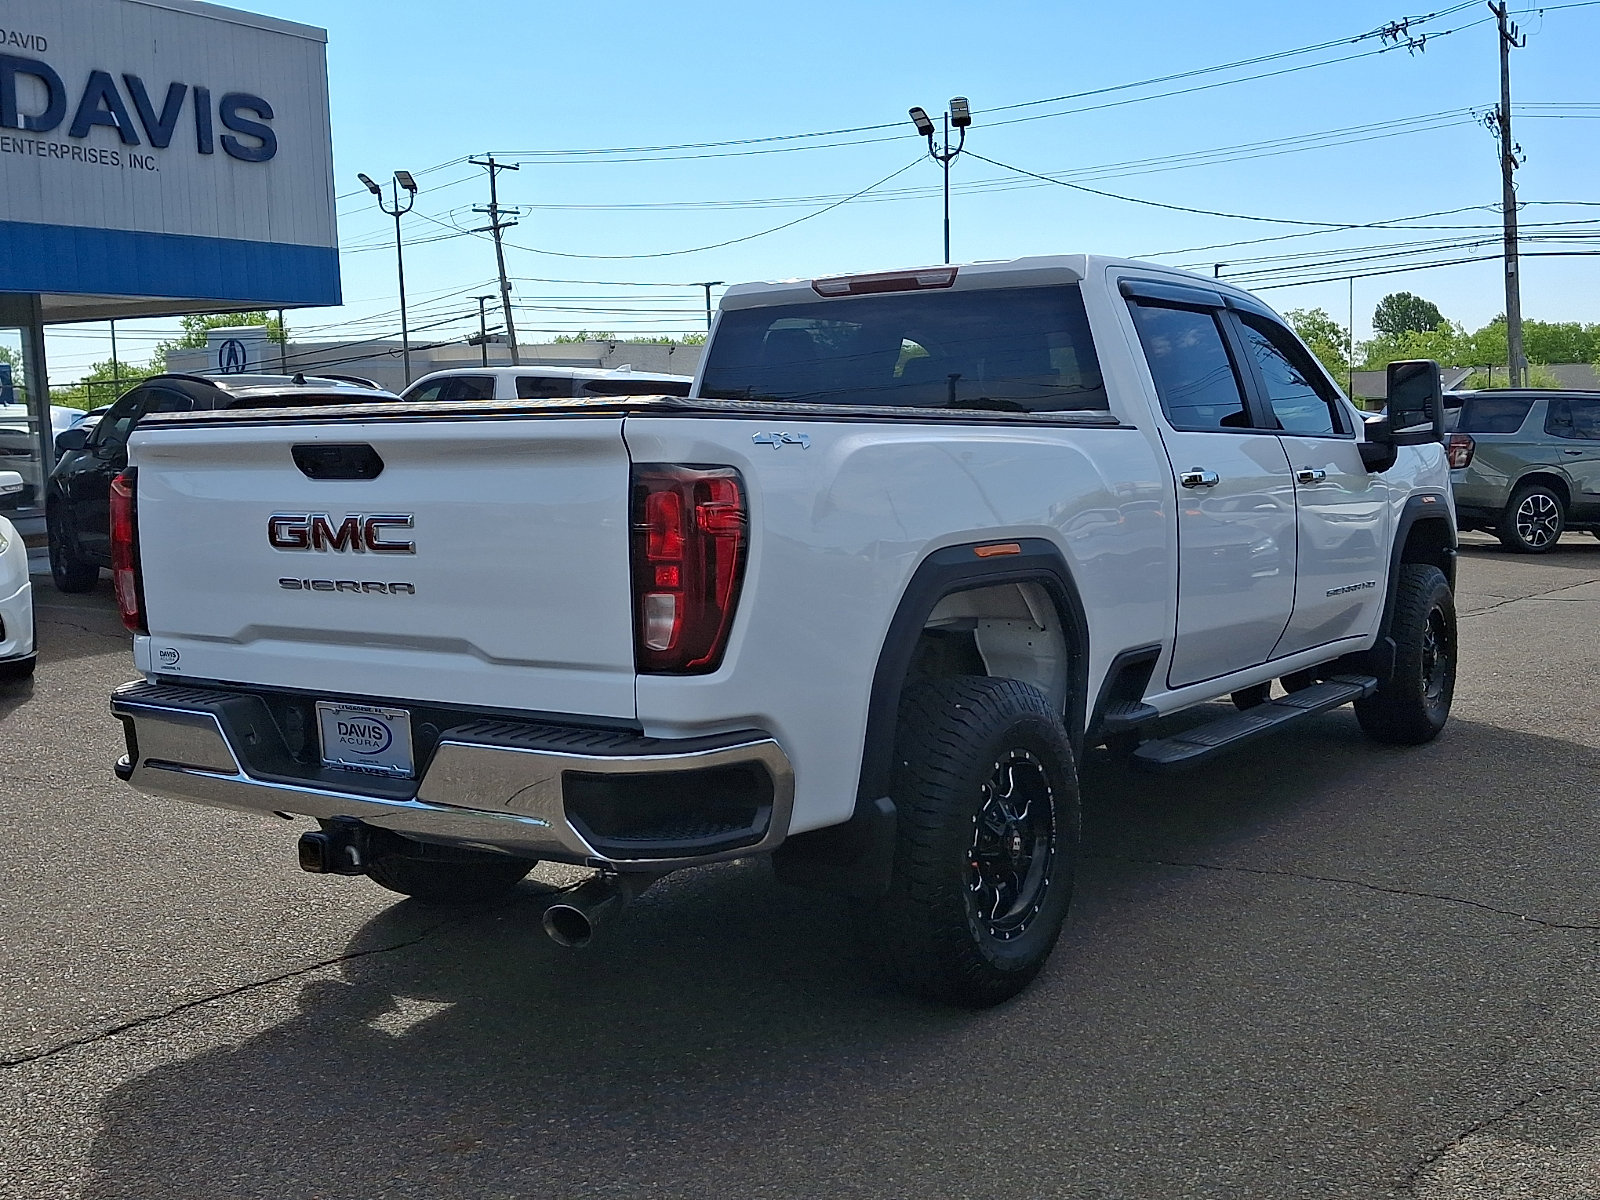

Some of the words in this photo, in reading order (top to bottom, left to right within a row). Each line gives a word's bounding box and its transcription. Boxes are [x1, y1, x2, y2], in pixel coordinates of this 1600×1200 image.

[0, 54, 278, 163] DAVIS
[0, 136, 124, 169] ENTERPRISES,
[129, 153, 159, 172] INC.
[267, 513, 416, 555] GMC
[278, 577, 416, 595] SIERRA
[337, 721, 383, 741] DAVIS
[340, 737, 380, 748] ACURA
